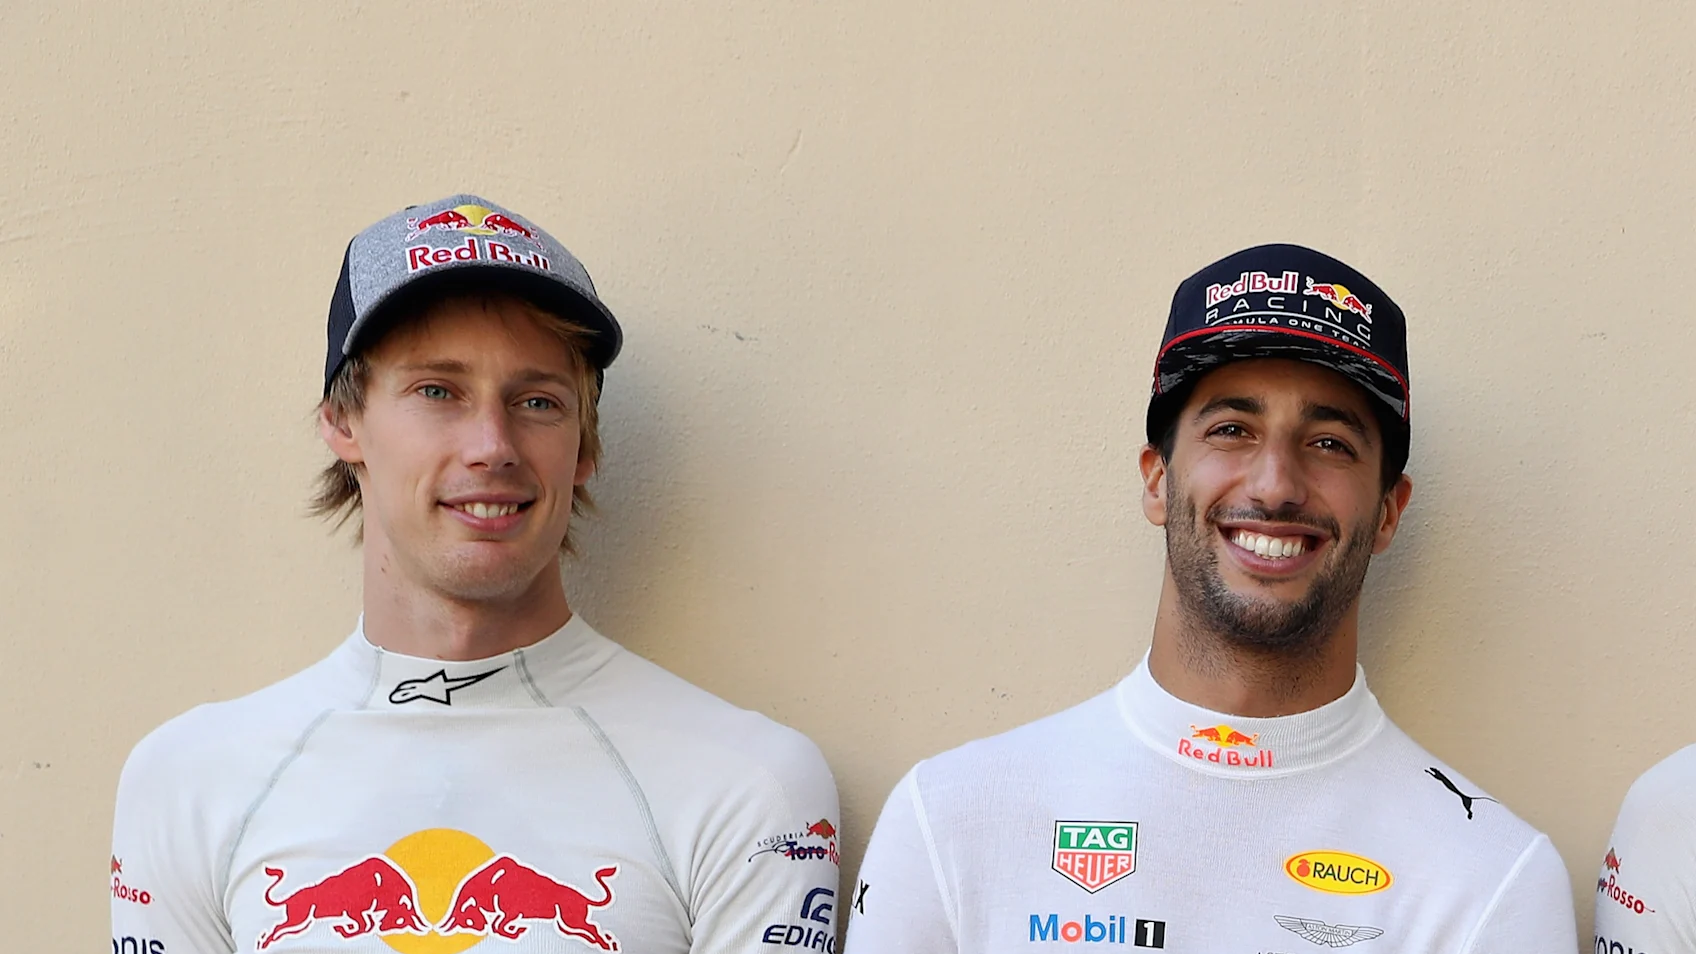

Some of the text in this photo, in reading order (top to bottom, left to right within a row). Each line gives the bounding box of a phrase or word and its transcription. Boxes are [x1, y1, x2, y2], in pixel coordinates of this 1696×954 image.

[407, 238, 549, 271] Red Bull
[1207, 271, 1298, 308] Red Bull
[1205, 296, 1371, 341] RACING
[1289, 318, 1323, 332] ONE
[1178, 739, 1272, 767] Red Bull
[757, 832, 804, 847] SCUDERIA
[784, 841, 827, 860] Toro
[1063, 827, 1128, 848] TAG
[1059, 854, 1130, 885] HEUER
[1313, 862, 1379, 886] RAUCH
[1607, 873, 1646, 915] Rosso
[1029, 914, 1126, 943] Mobil
